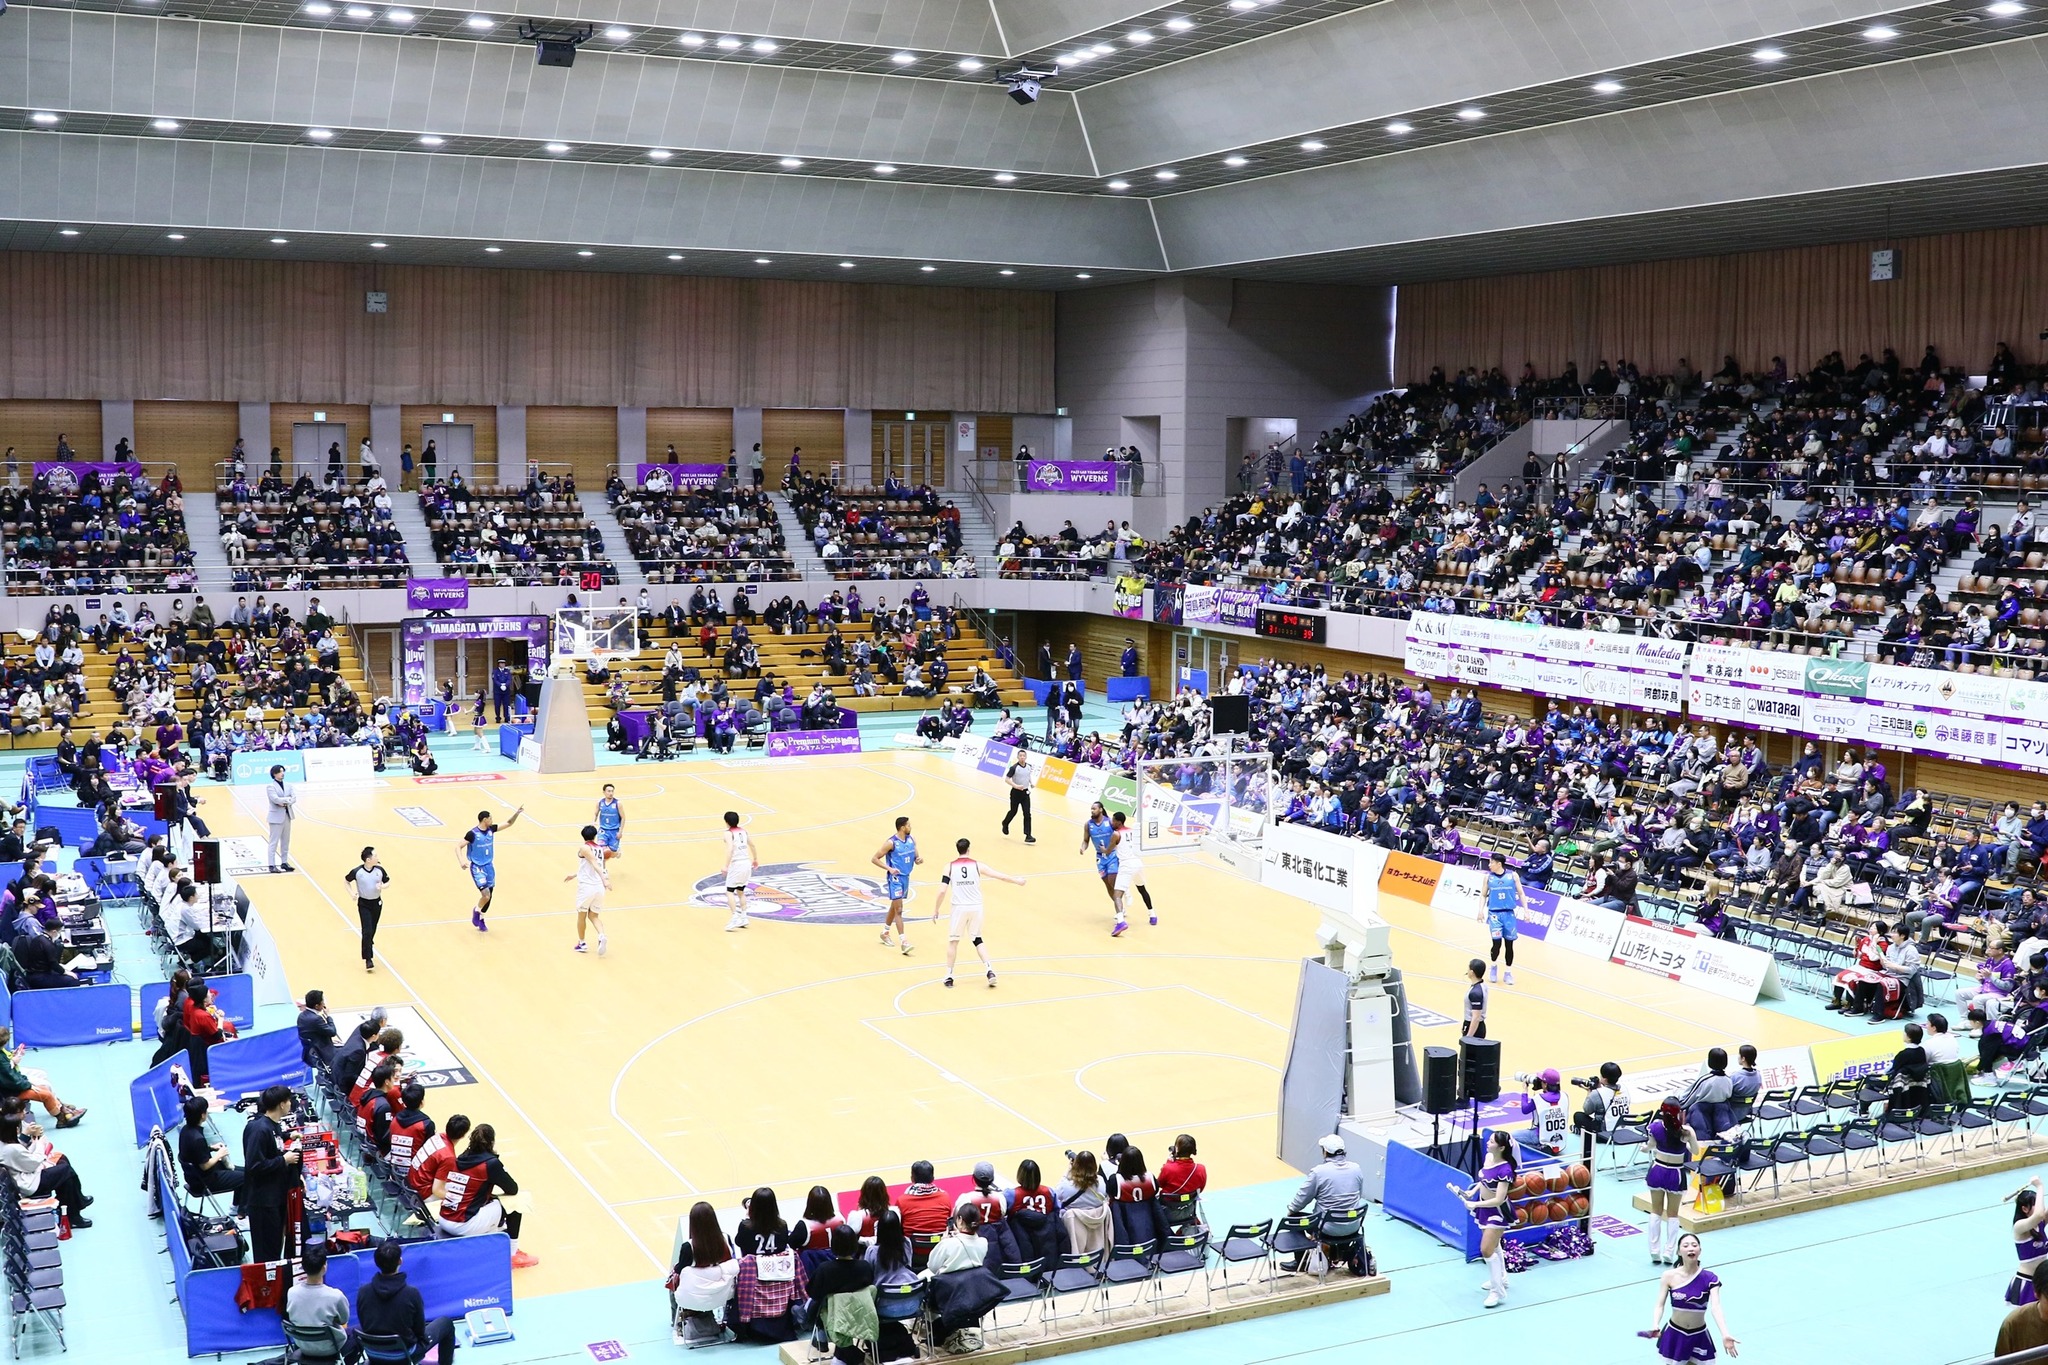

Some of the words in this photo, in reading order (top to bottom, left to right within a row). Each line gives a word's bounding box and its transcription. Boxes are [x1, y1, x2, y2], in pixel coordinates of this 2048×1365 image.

[1070, 474, 1108, 483] WYVERNS
[582, 573, 599, 589] 20
[430, 624, 476, 634] YAMAGATA
[478, 622, 522, 632] WYVERNS
[1414, 618, 1424, 632] K
[1424, 620, 1433, 634] &
[1435, 622, 1446, 636] M
[1636, 642, 1682, 660] Montedio
[1456, 654, 1470, 664] CLUB
[1470, 656, 1484, 666] SAND
[1644, 658, 1670, 666] YAMAGATA
[1466, 666, 1488, 676] MARKET
[1883, 678, 1932, 692] アリオンテック
[1644, 687, 1678, 704] 阿部玩具
[1705, 693, 1742, 710] 日本生命
[1813, 714, 1856, 726] CHINO
[1882, 716, 1912, 731] 三和缶詰
[788, 736, 820, 746] Premium
[822, 734, 842, 744] Seats
[1950, 728, 1998, 746] 遠藤商事
[795, 744, 836, 752] プレミアムシート
[2006, 736, 2048, 756] コマツ
[195, 850, 203, 859] T
[961, 866, 968, 878] 9
[1282, 852, 1348, 888] 東北電化工業
[1652, 922, 1674, 932] TOYOTA
[1620, 940, 1686, 970] 山形トヨタ
[96, 1026, 122, 1034] Nittaku
[1760, 1064, 1798, 1089] 証券
[1612, 1104, 1629, 1117] 003
[1546, 1119, 1566, 1132] 003
[1022, 1194, 1046, 1214] 33
[980, 1203, 992, 1223] 7
[754, 1234, 778, 1254] 24
[464, 1296, 499, 1308] Nittaku
